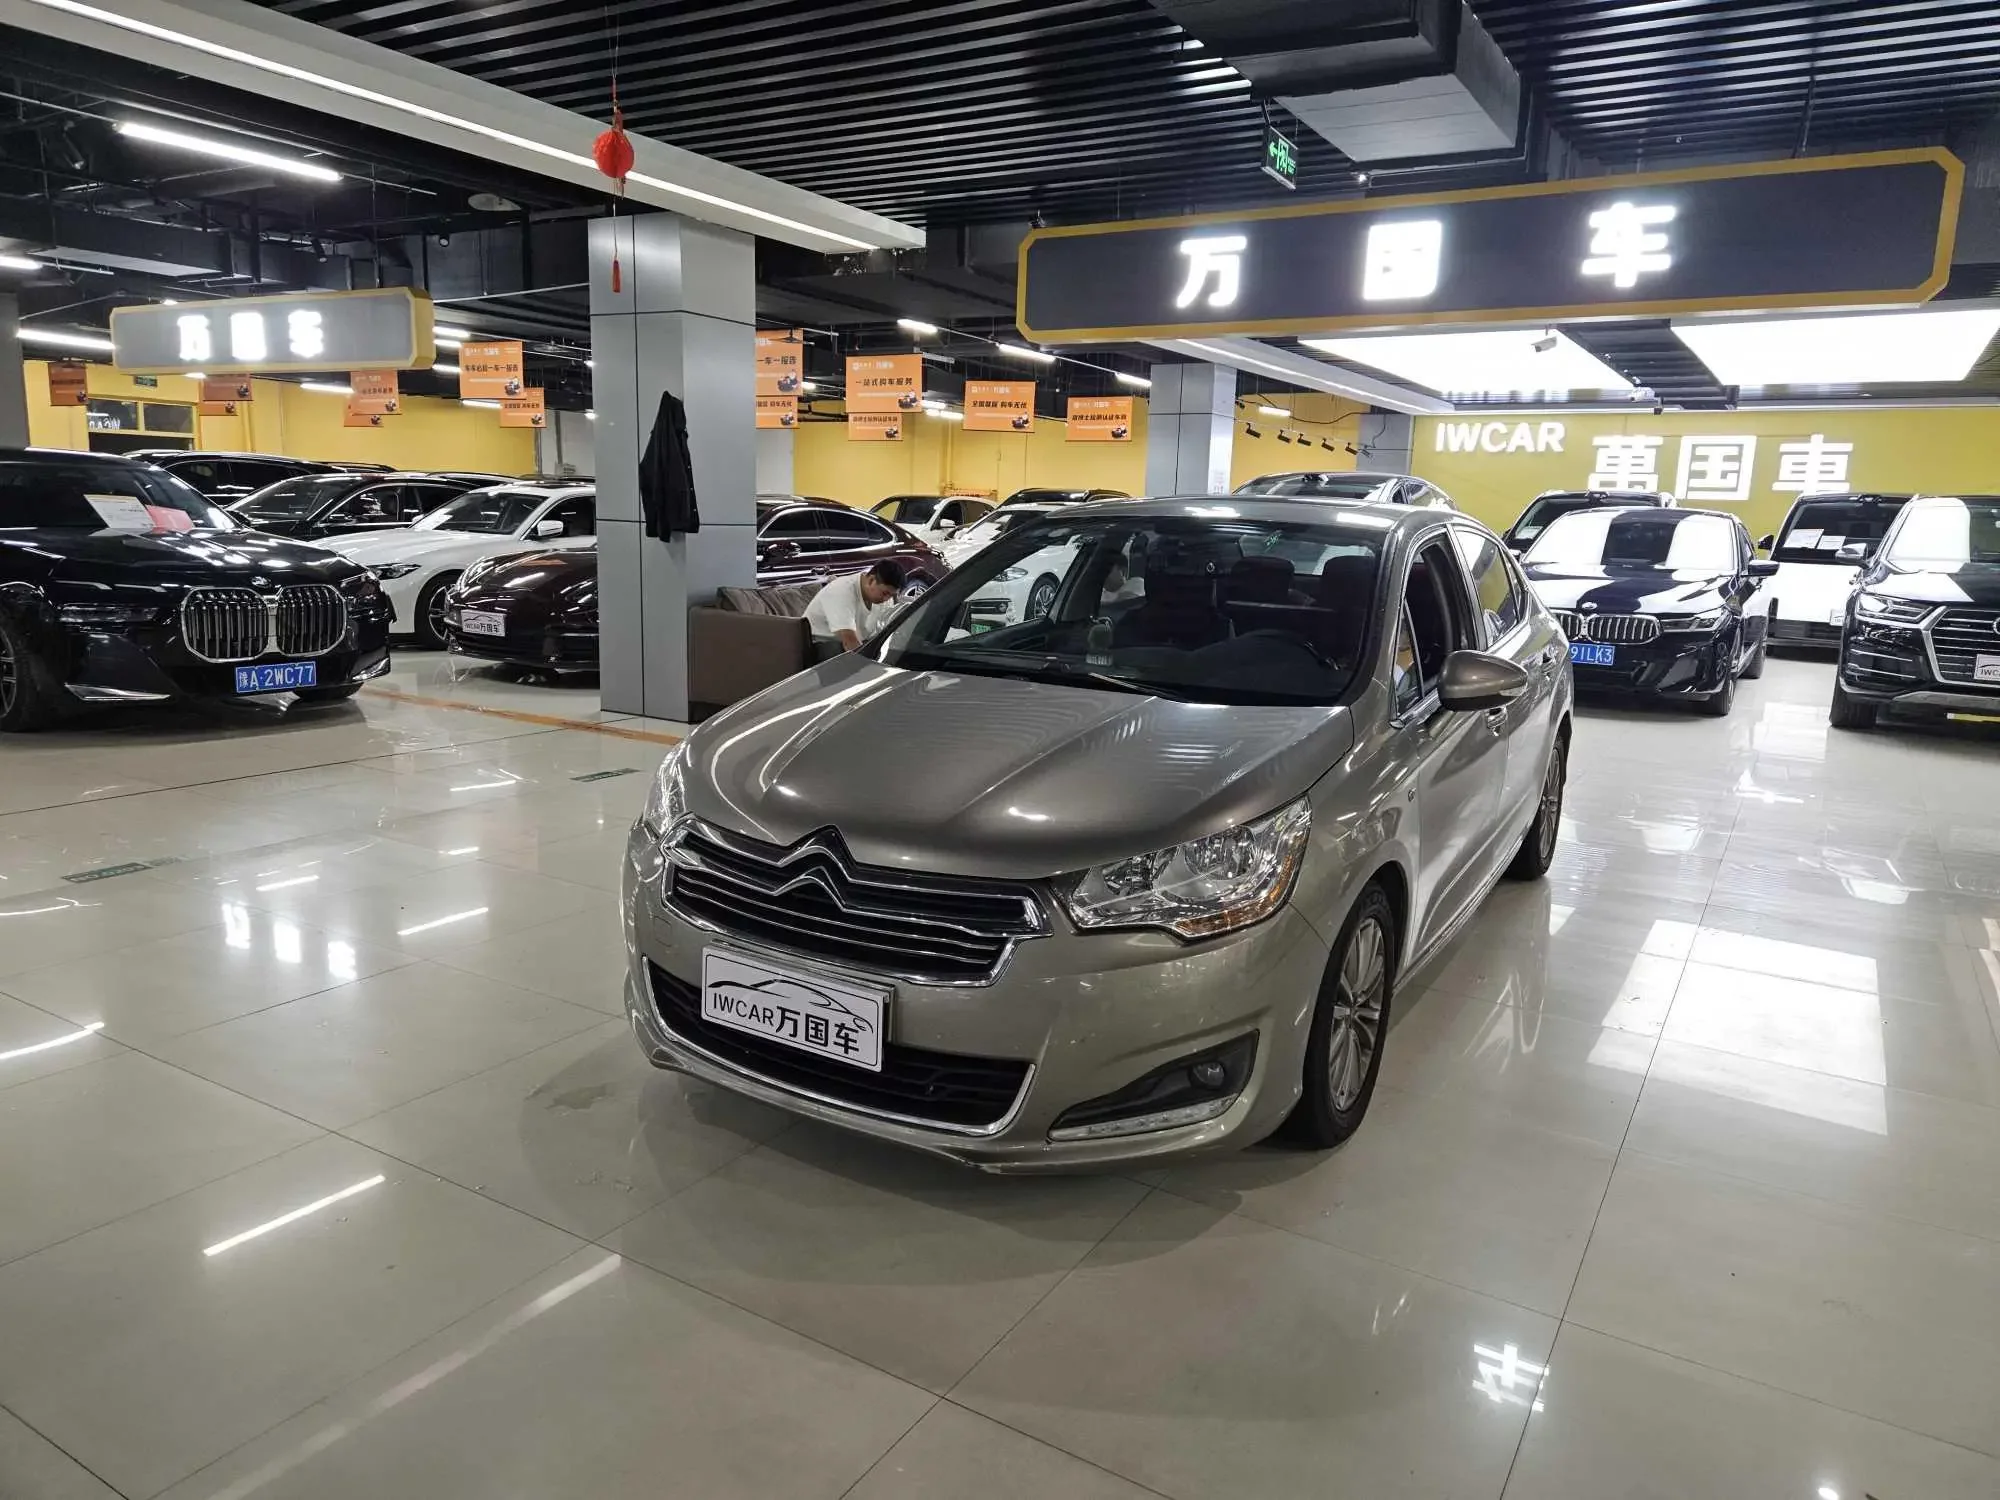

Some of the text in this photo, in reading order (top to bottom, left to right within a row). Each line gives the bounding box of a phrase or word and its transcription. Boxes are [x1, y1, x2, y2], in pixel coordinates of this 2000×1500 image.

[856, 377, 913, 387] 一站式购车服务
[1434, 421, 1566, 453] IWCAR
[1981, 668, 2000, 677] IWC
